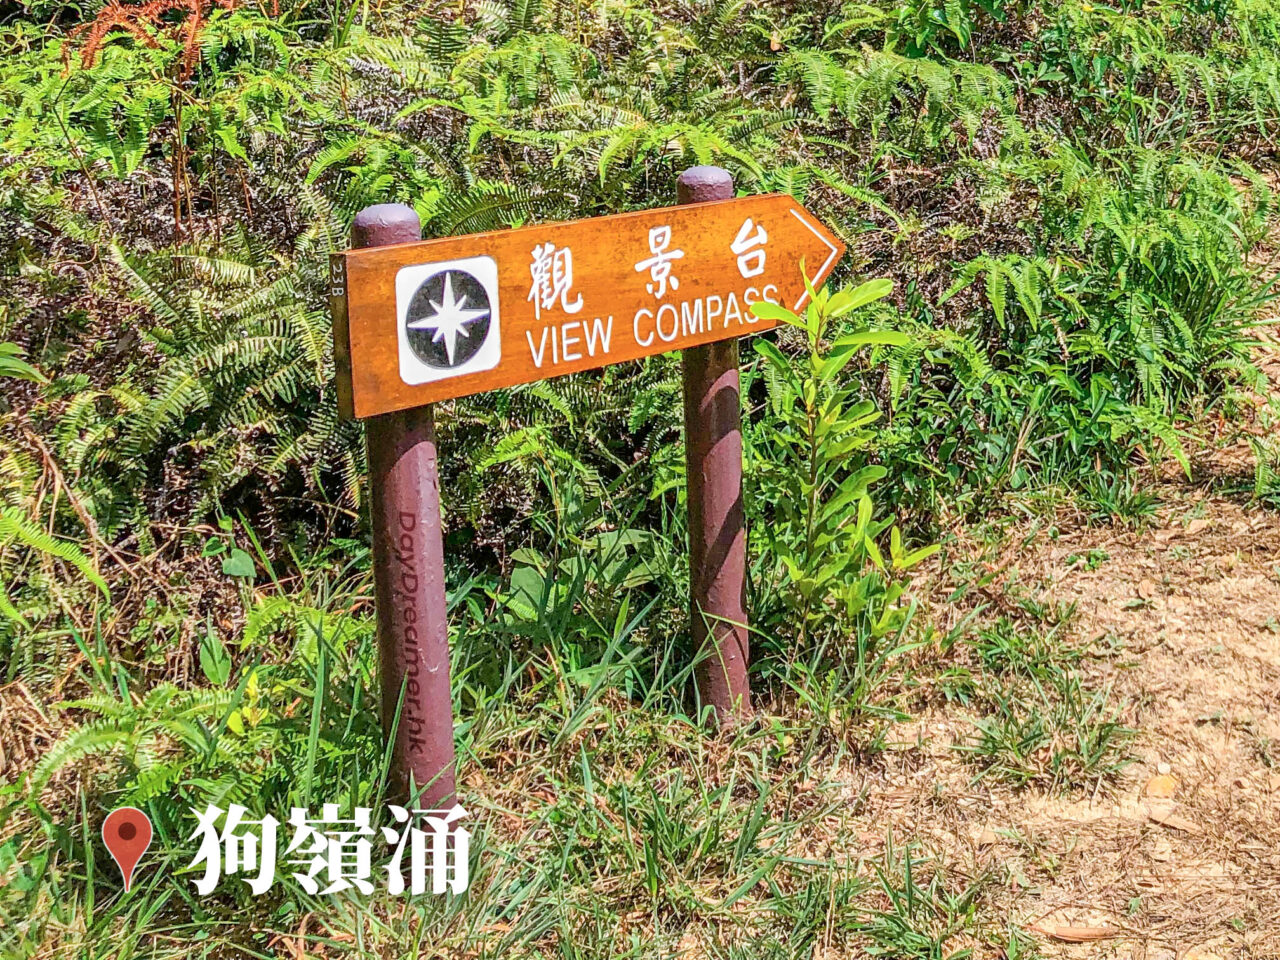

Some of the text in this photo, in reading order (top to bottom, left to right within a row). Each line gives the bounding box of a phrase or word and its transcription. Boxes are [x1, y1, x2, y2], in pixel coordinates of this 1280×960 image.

[331, 263, 345, 297] 23B
[528, 217, 769, 321] 觀景台
[526, 314, 614, 368] VIEW
